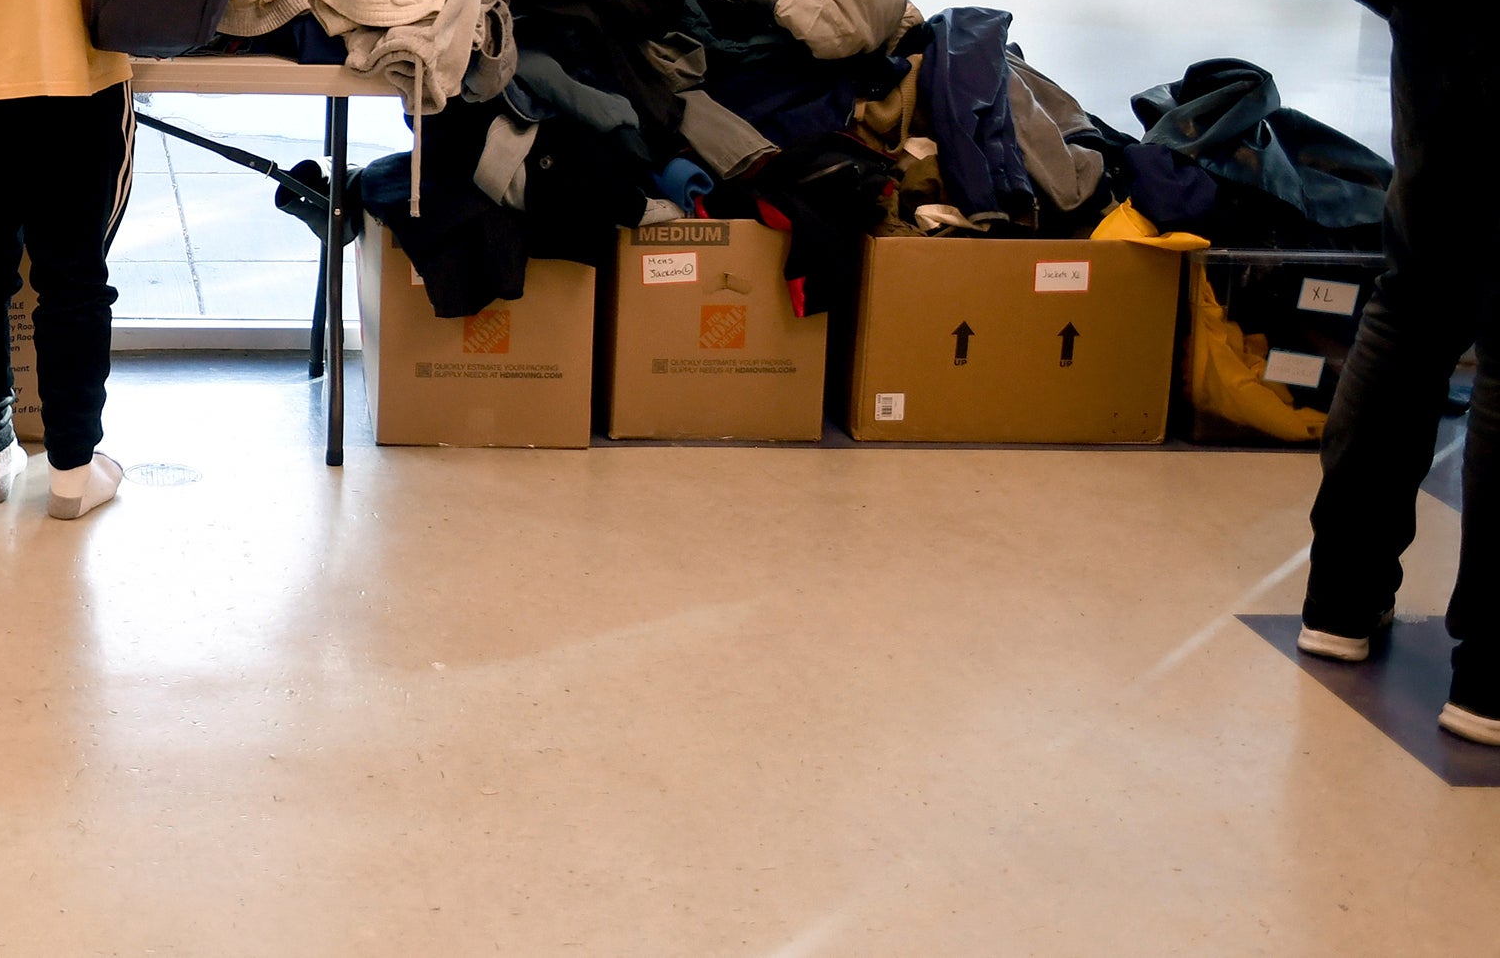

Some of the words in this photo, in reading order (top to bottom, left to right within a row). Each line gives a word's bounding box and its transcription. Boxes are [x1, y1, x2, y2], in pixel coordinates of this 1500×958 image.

[639, 226, 722, 242] MEDIUM
[648, 257, 674, 265] Mens
[1312, 286, 1333, 302] XL
[1059, 360, 1073, 368] UP
